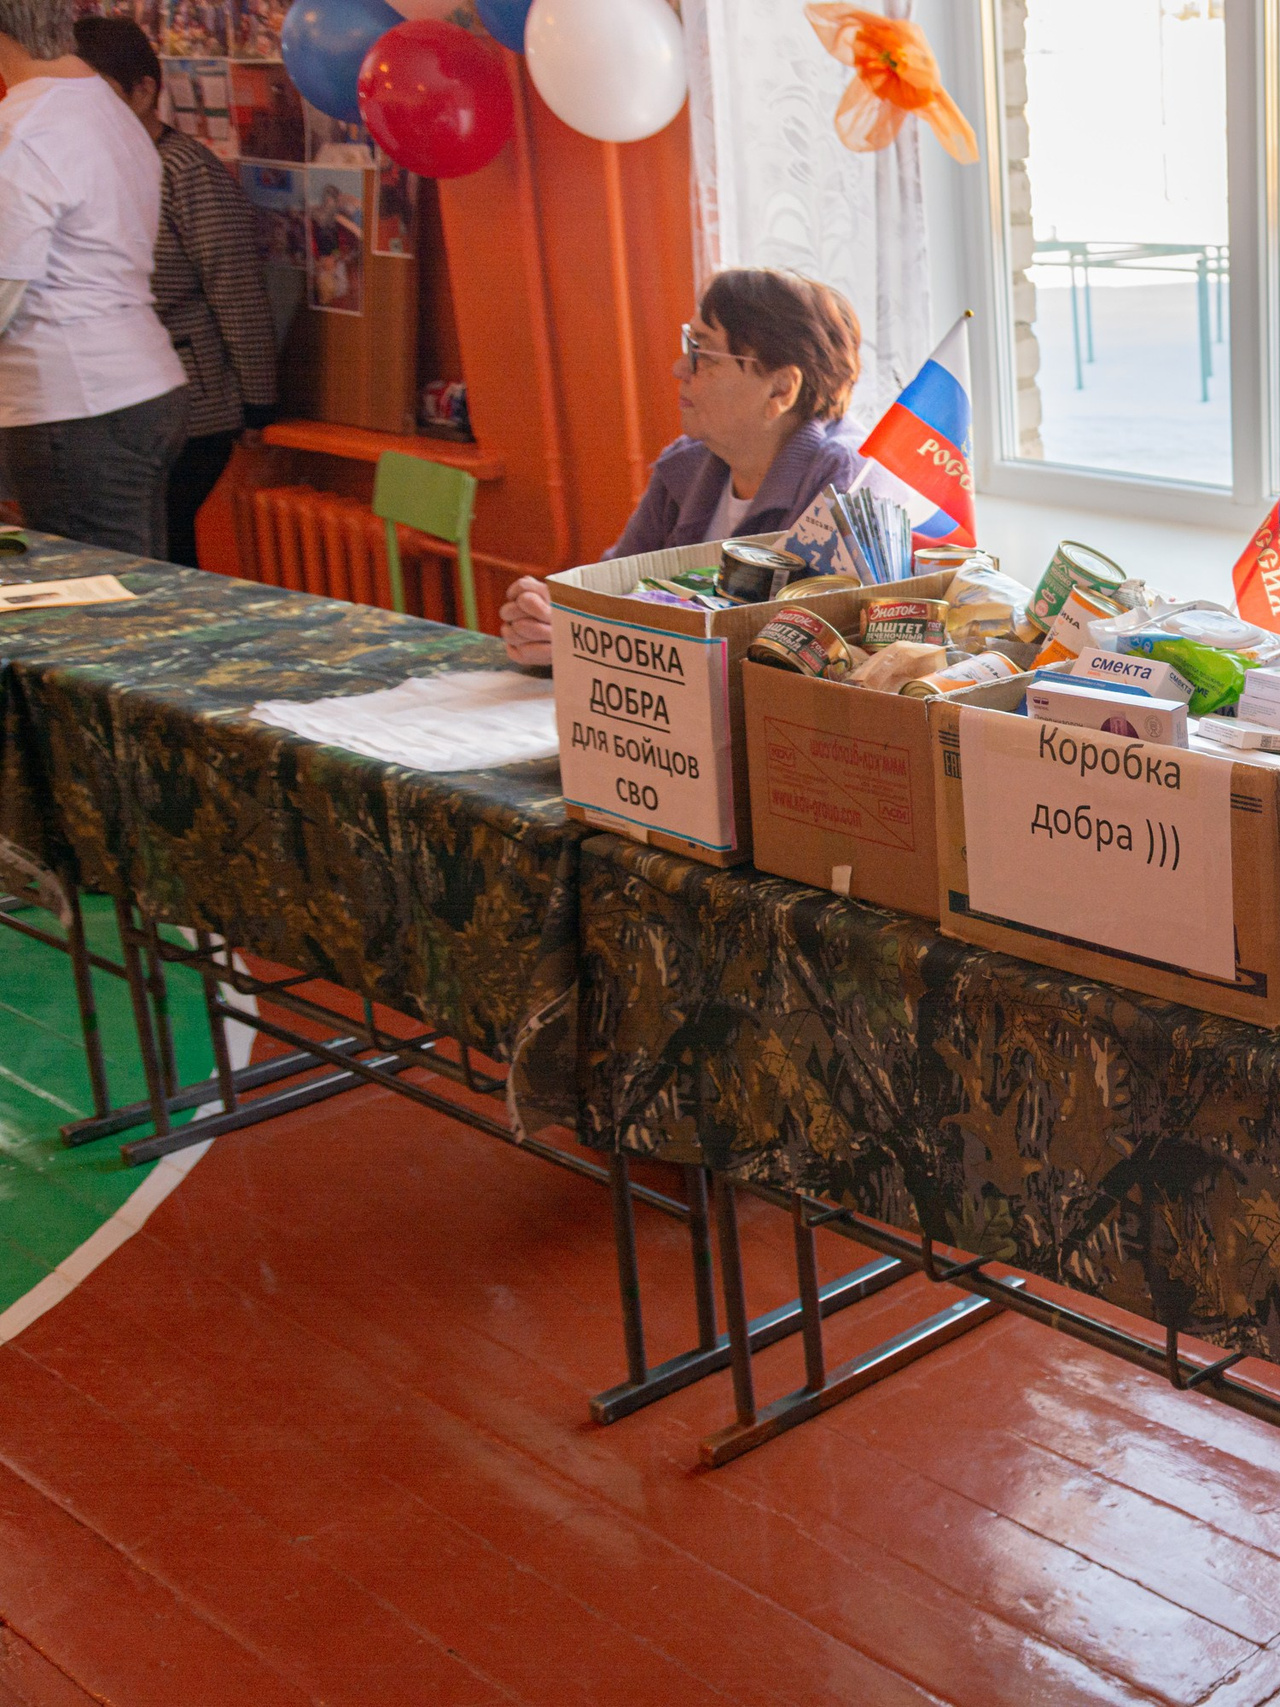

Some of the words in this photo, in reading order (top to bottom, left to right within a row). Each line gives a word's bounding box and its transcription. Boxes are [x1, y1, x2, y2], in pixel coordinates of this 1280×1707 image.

[917, 438, 973, 491] РОСС
[571, 621, 685, 677] КОРОБКА
[868, 622, 923, 634] ПАШТЕТ
[590, 677, 670, 725] ДОБРА
[572, 721, 609, 753] ДЛЯ
[613, 735, 700, 779] БОЙЦОВ
[1039, 724, 1181, 790] Коробка
[616, 777, 659, 811] СВО
[1031, 804, 1133, 852] добра
[1146, 819, 1180, 871] )))
